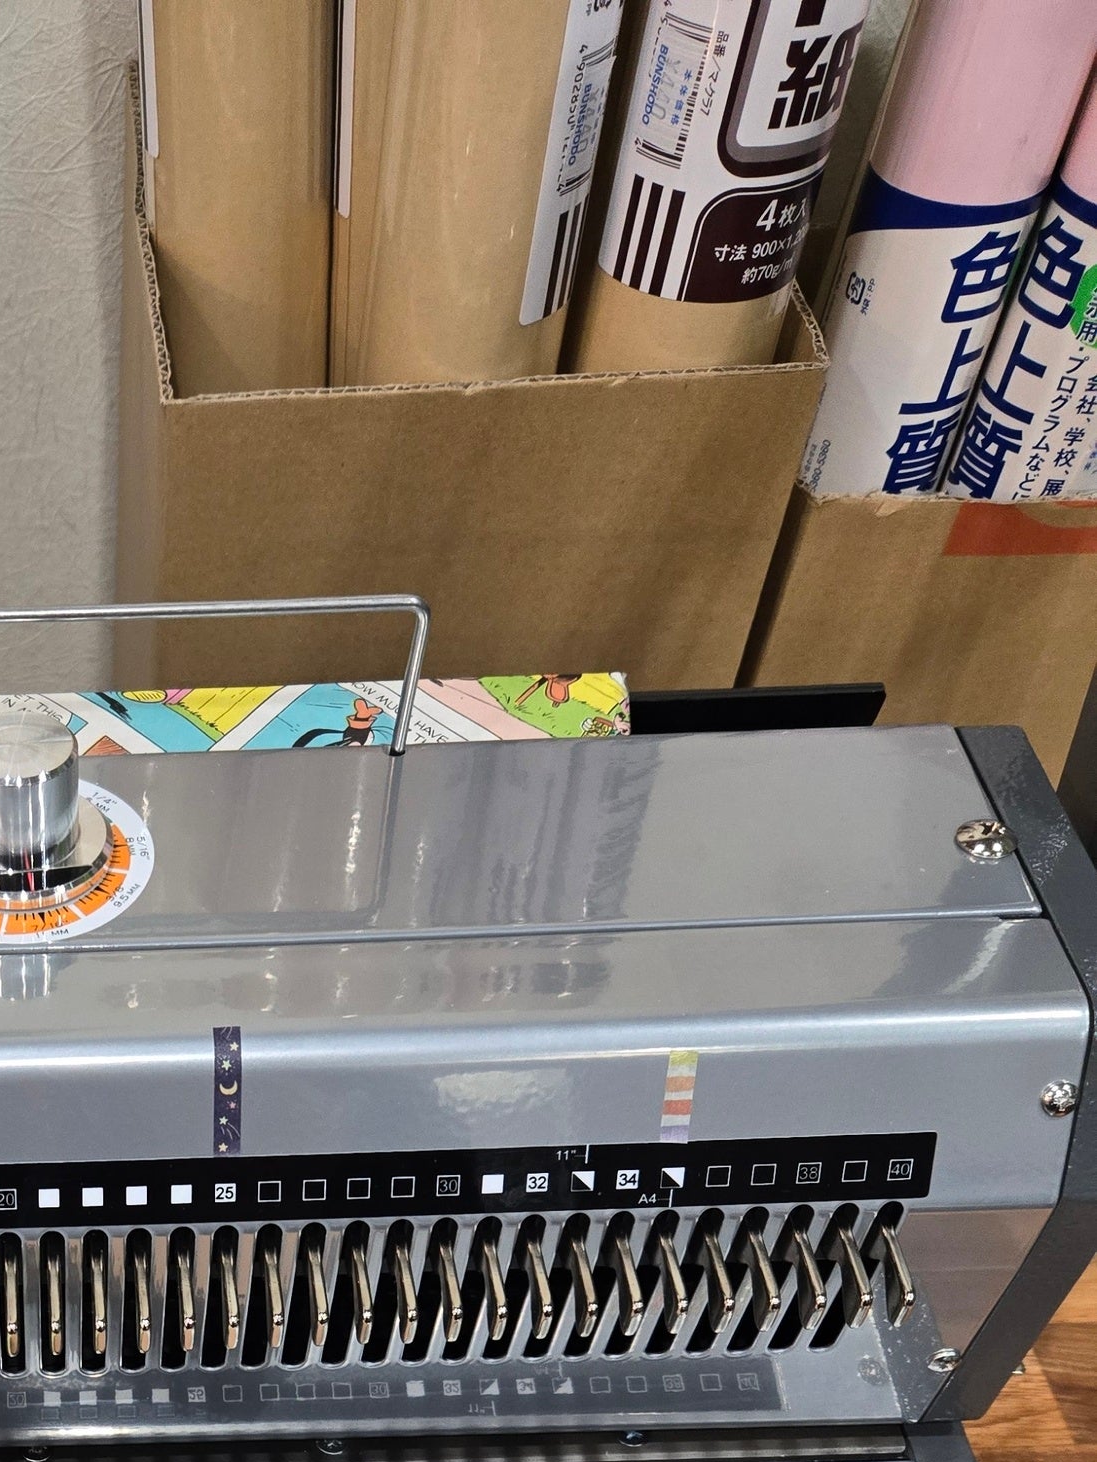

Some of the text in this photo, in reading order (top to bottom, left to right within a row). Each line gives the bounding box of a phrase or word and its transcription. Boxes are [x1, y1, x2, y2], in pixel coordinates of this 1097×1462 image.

[768, 0, 864, 130] 紙
[641, 44, 669, 126] BUNSHODO
[568, 83, 593, 167] BUNSHODO
[881, 230, 1023, 494] 色上質
[946, 213, 1085, 499] 色上質
[799, 1166, 819, 1181] 38
[890, 1162, 911, 1177] 40
[439, 1179, 459, 1194] 30
[527, 1176, 548, 1190] 32
[618, 1172, 638, 1187] 34
[215, 1186, 235, 1200] 25
[637, 1193, 657, 1205] A4
